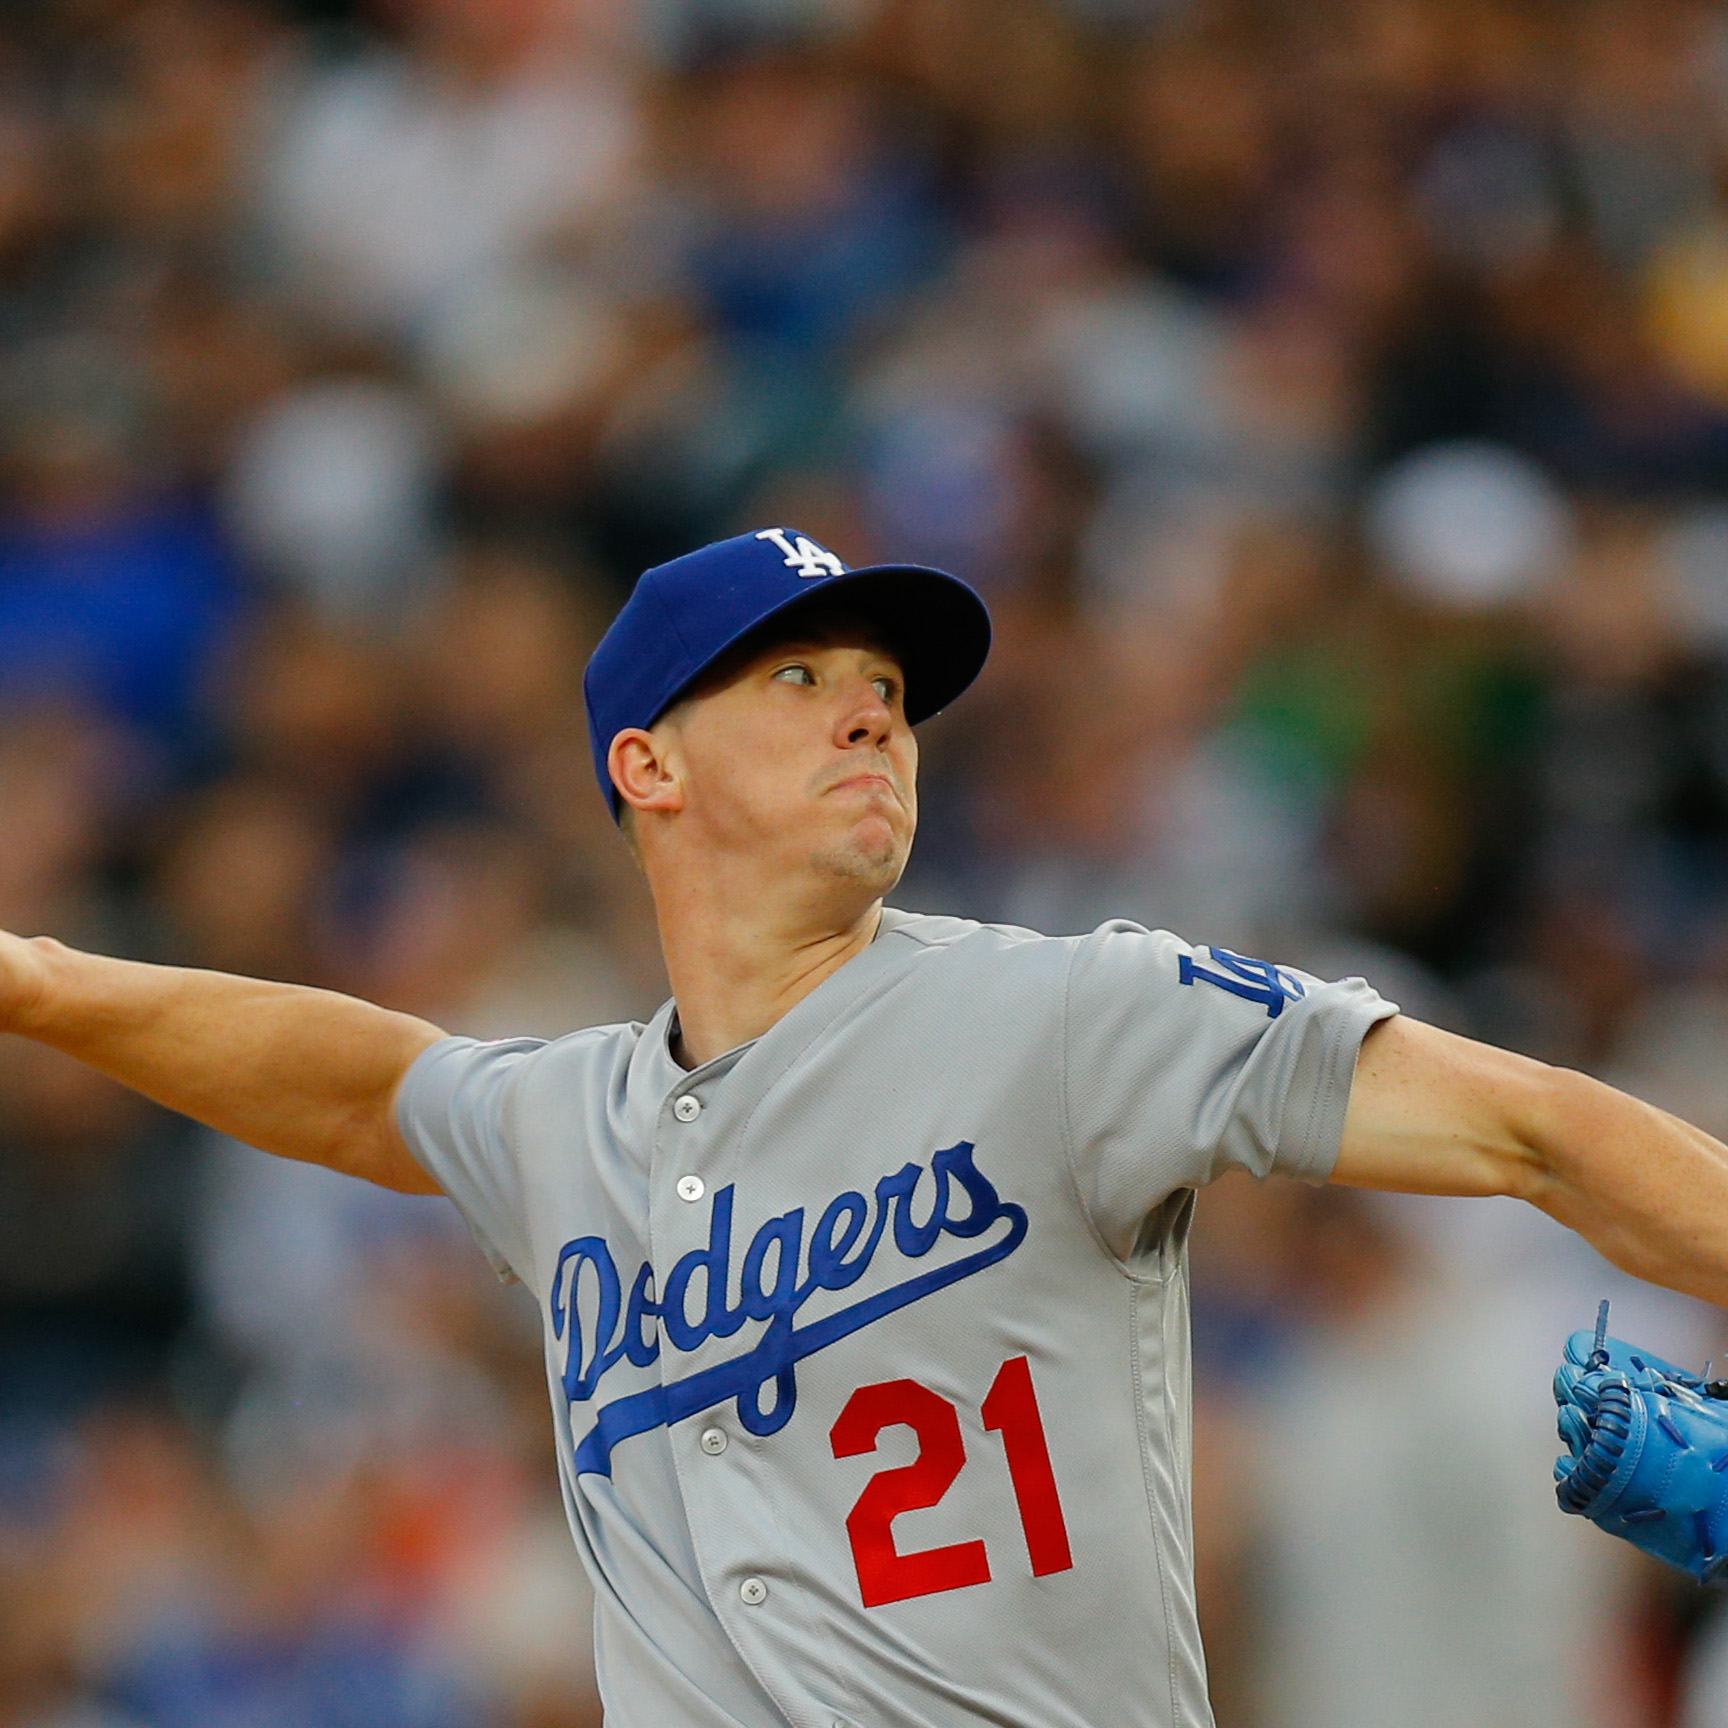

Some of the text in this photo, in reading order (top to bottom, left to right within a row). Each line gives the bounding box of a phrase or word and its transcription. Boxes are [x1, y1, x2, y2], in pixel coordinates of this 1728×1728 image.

[754, 527, 846, 577] LA
[551, 1140, 1028, 1438] Dodgers
[829, 1355, 1073, 1608] 21
